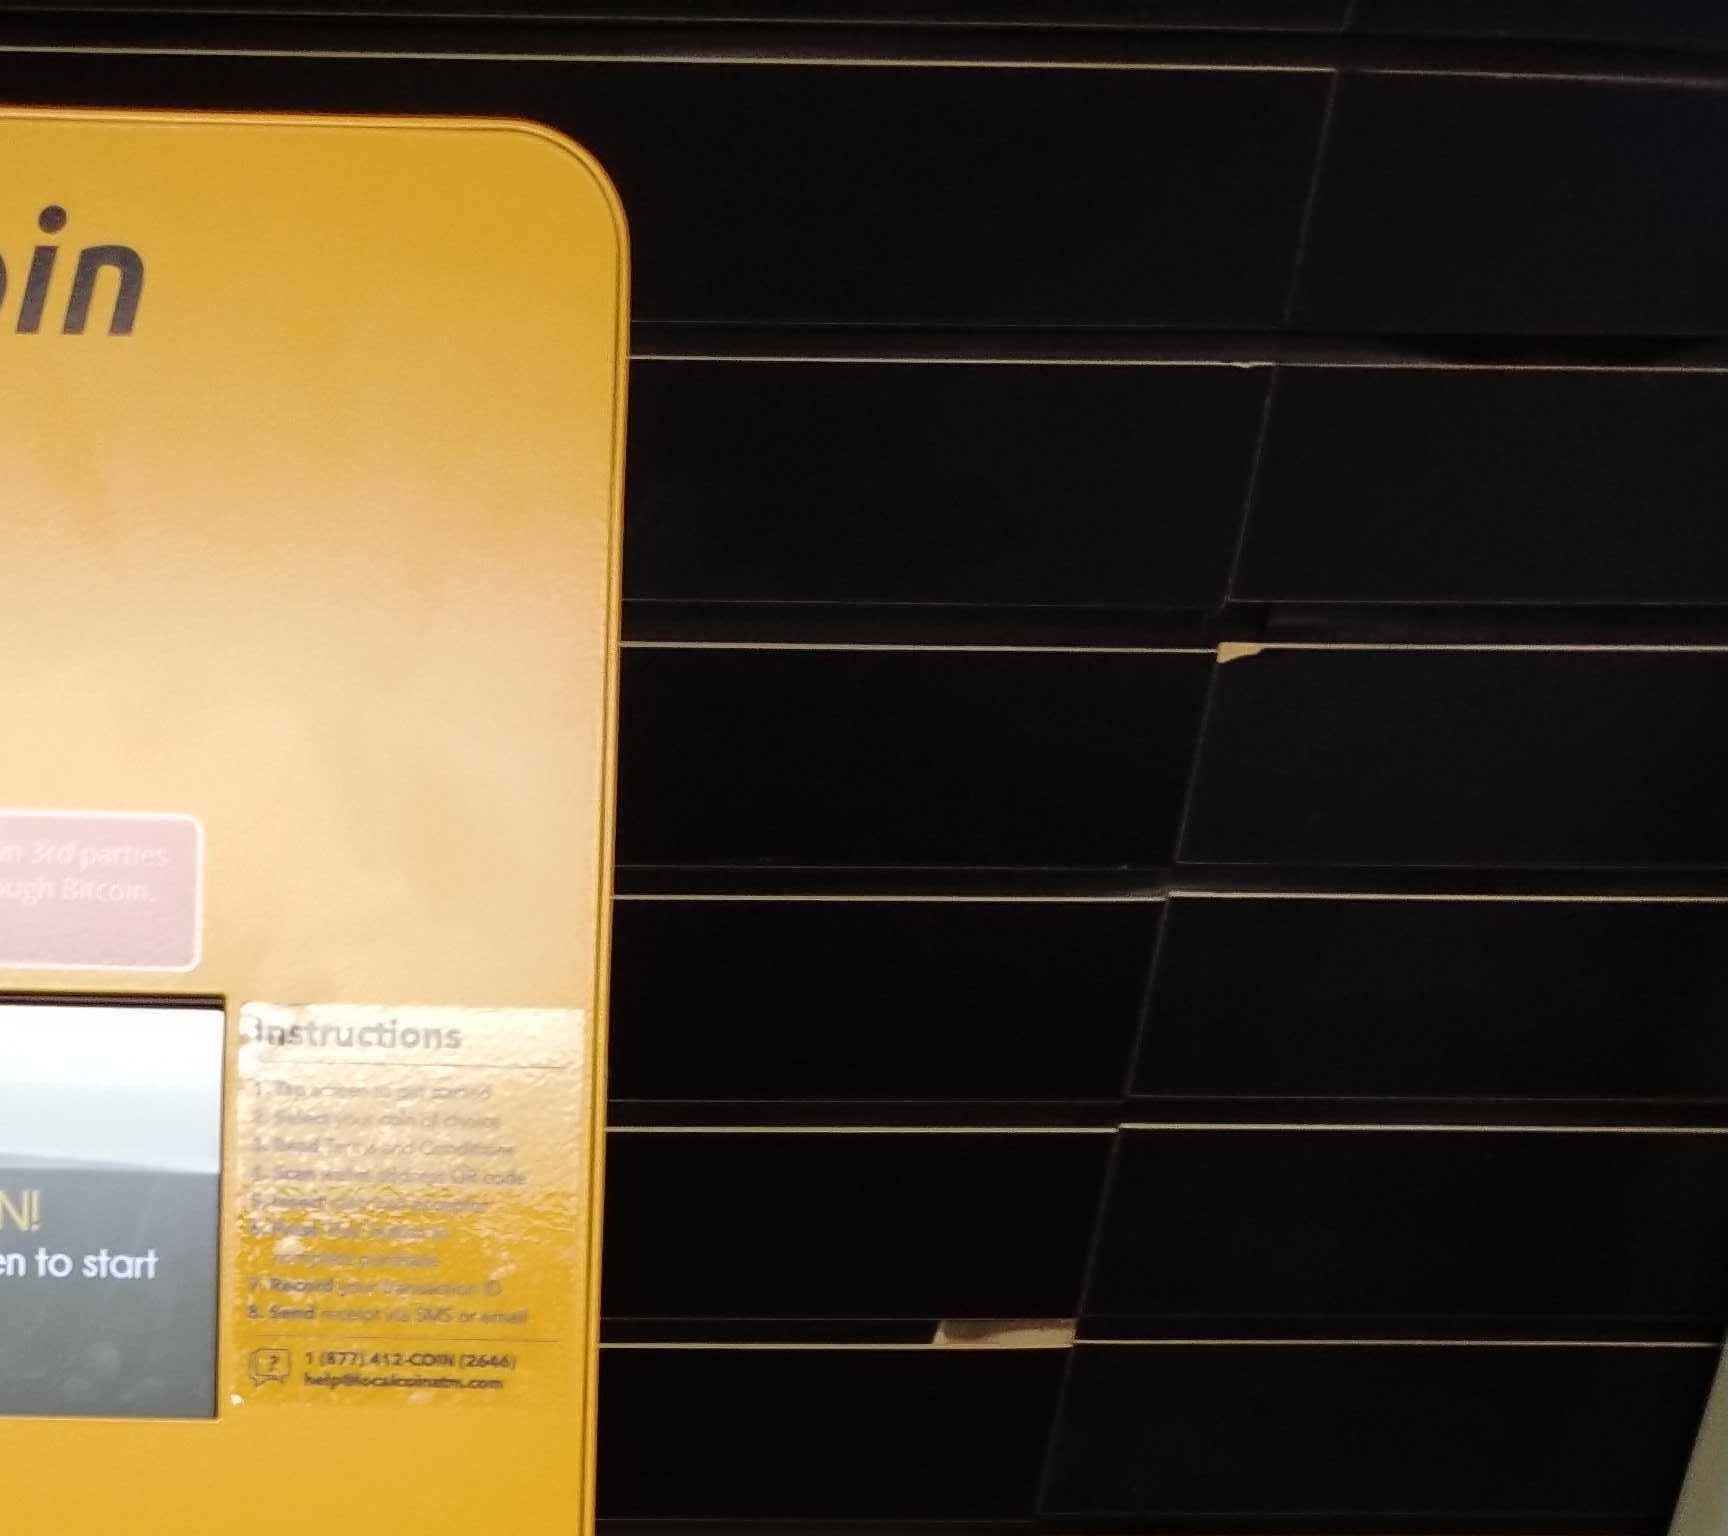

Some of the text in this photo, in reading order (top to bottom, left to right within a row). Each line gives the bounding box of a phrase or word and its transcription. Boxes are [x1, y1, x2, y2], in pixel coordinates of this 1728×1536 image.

[255, 1018, 462, 1049] Instructions
[36, 1248, 72, 1278] to
[82, 1248, 157, 1280] start
